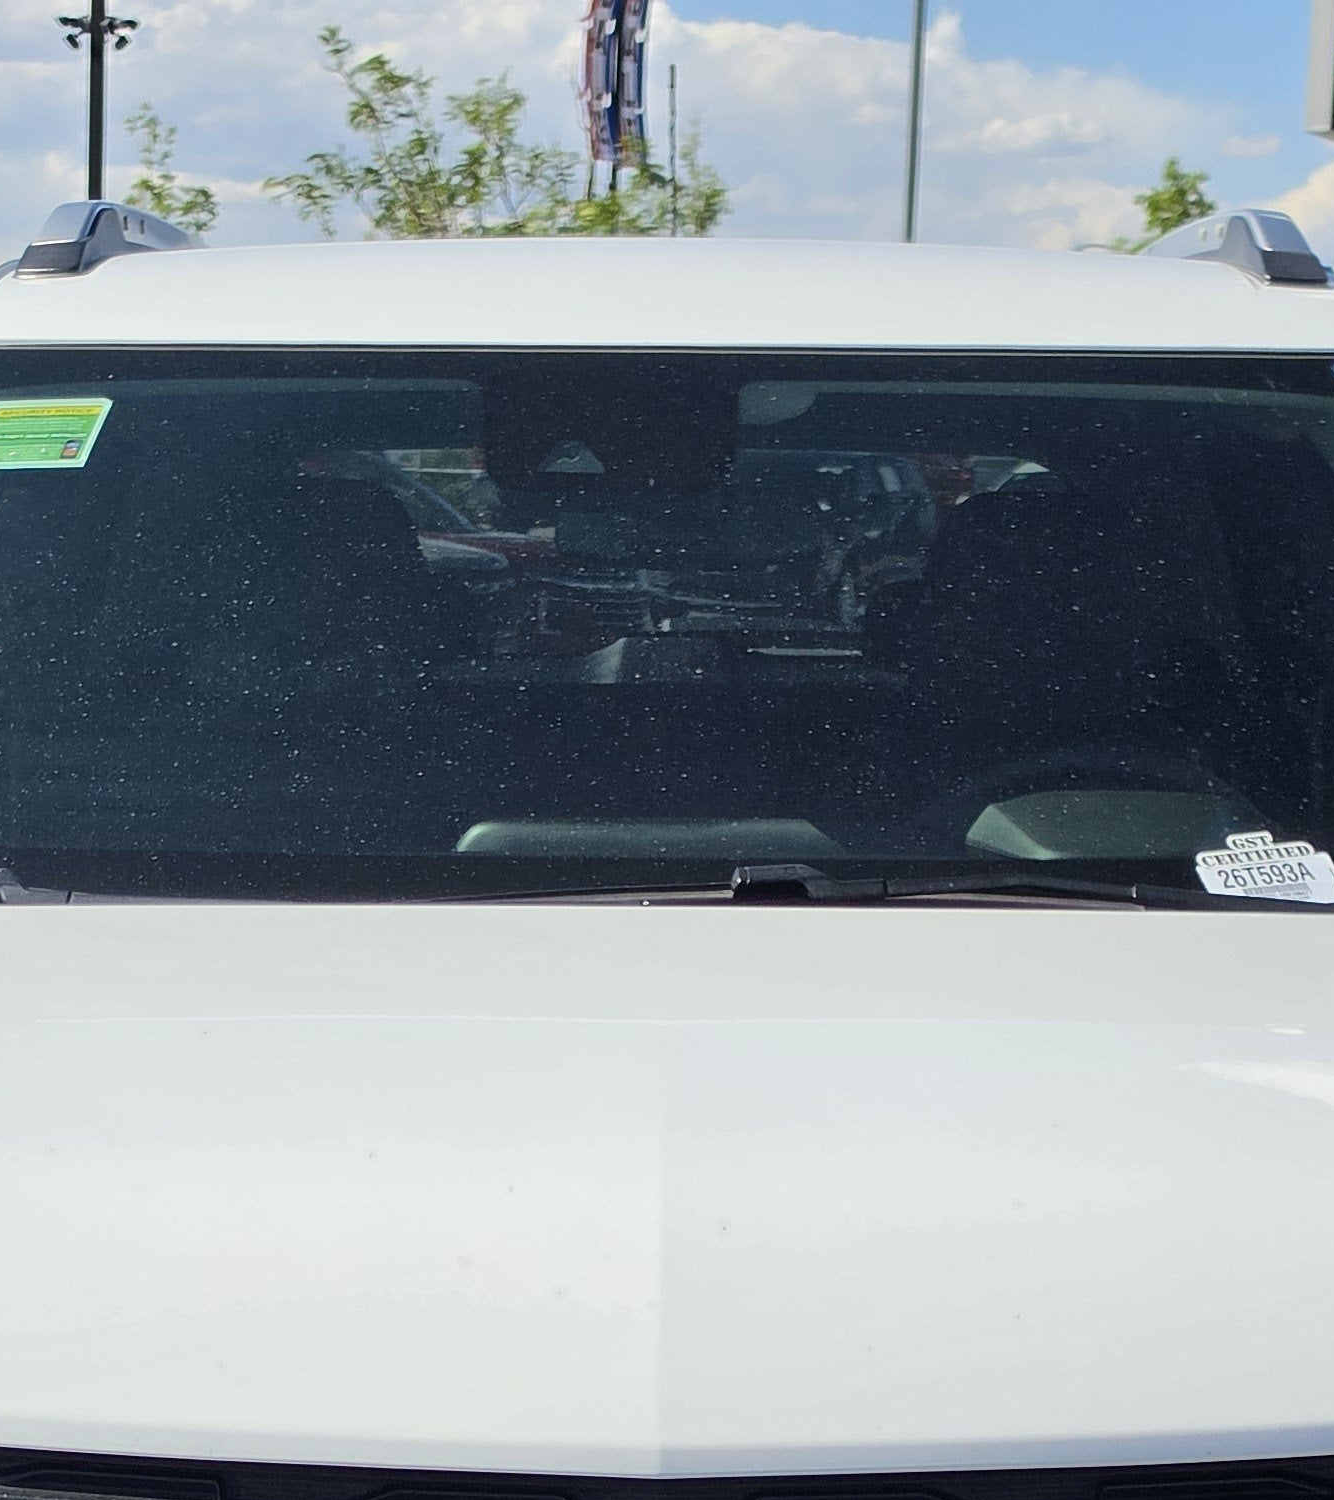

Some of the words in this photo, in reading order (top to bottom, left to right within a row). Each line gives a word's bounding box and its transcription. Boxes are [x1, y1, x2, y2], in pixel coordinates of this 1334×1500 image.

[1232, 835, 1271, 850] GST
[1201, 845, 1310, 867] CERTIFIED
[1218, 862, 1316, 889] 26T593A
